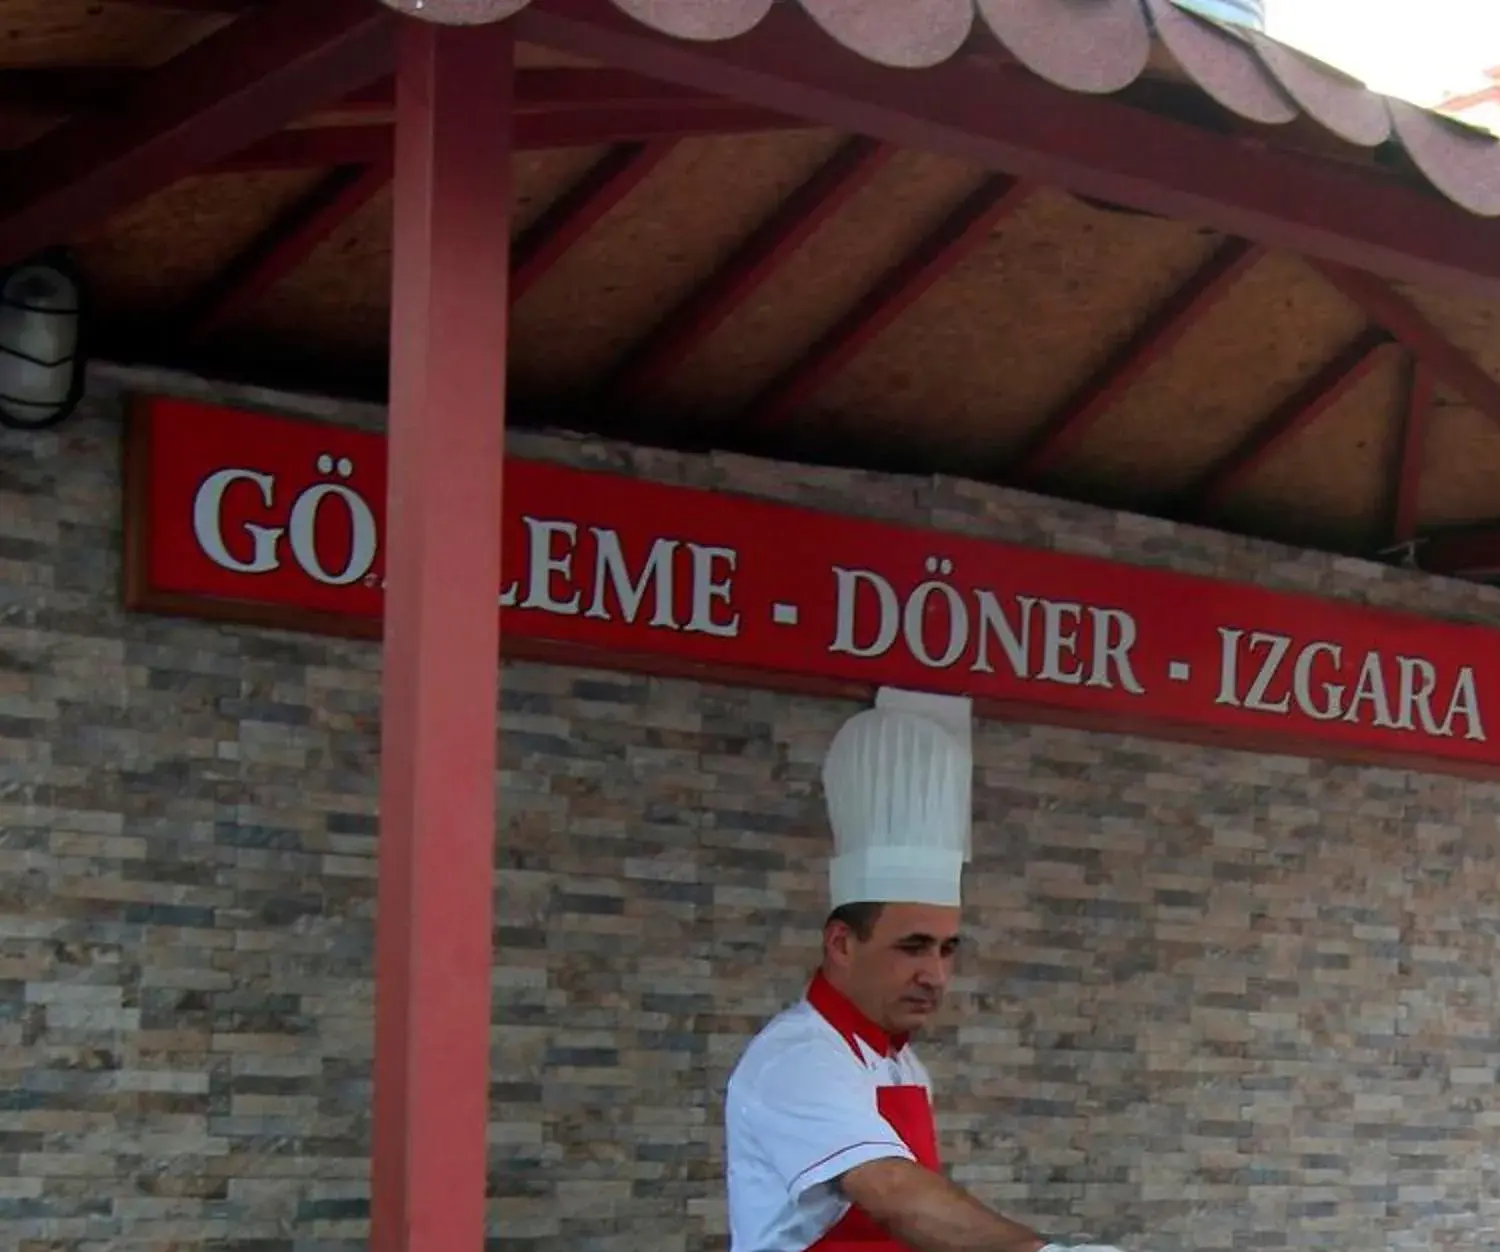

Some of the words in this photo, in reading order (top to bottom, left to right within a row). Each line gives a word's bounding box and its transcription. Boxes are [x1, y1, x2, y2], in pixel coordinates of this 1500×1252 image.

[193, 453, 740, 637] GÖEME
[828, 555, 1146, 695] DÖNER
[1214, 626, 1488, 742] IZGARA
